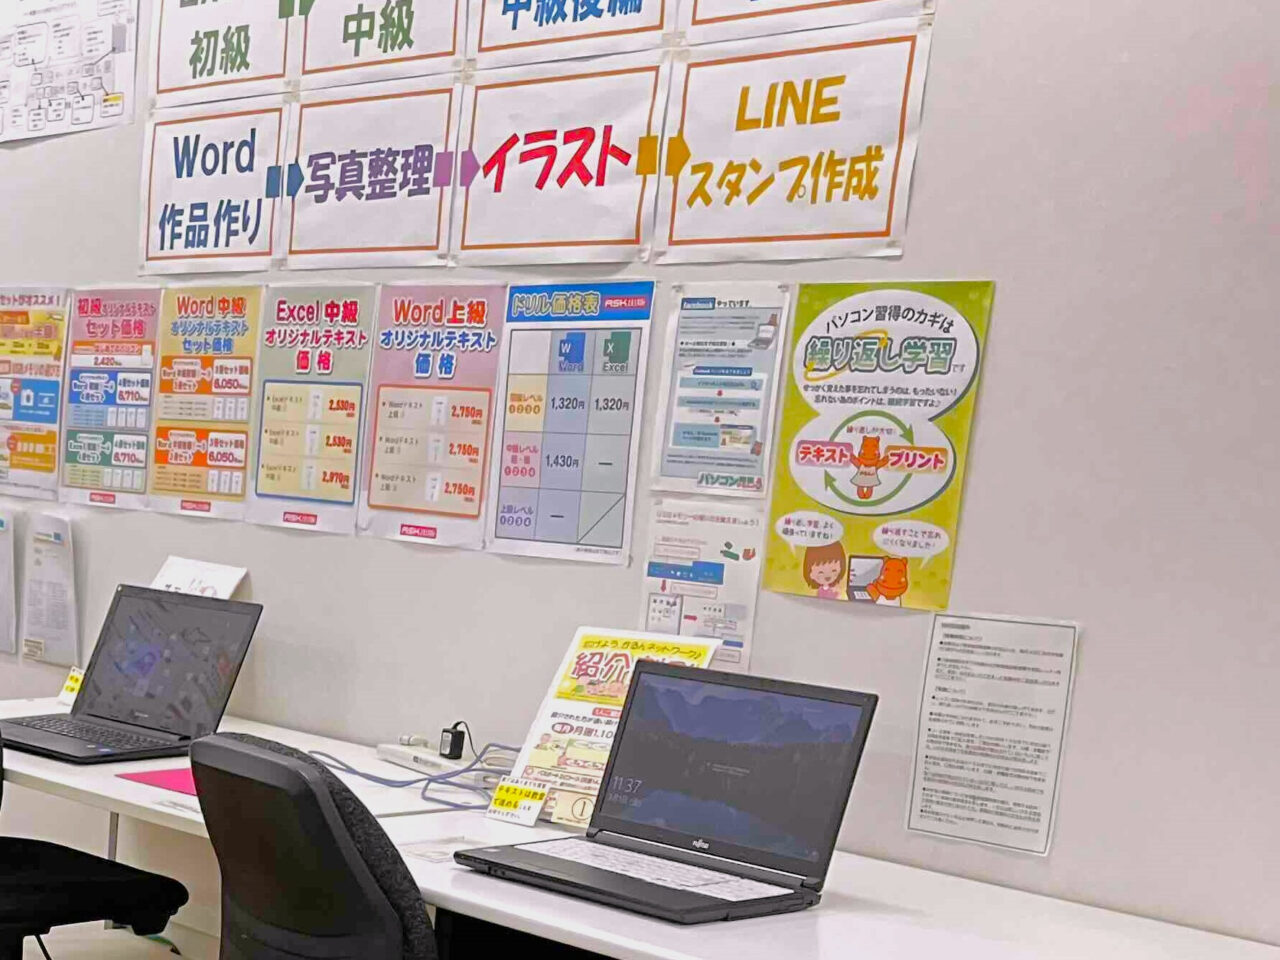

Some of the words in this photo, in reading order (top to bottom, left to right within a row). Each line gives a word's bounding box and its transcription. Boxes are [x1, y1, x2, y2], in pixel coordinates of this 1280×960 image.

[342, 0, 415, 58] 中級
[190, 22, 252, 80] 初級
[735, 74, 845, 133] LINE
[172, 127, 256, 180] Word
[482, 124, 633, 194] イラスト
[303, 142, 436, 204] 写真整理
[685, 146, 880, 209] スタンプ作成
[159, 198, 263, 253] 作品作り
[177, 295, 214, 318] Word
[218, 295, 248, 318] 中級
[275, 299, 320, 323] Excel
[324, 299, 359, 325] 中級
[393, 298, 444, 325] Word
[446, 299, 487, 326] 上級
[511, 290, 601, 318] ドリル価格表
[826, 304, 955, 334] パソコン習得のカギは
[264, 328, 369, 348] オリジナルテキスト
[380, 329, 497, 349] オリジナルテキスト
[295, 349, 333, 373] 価格
[414, 352, 456, 377] 価格
[602, 360, 629, 373] Excel
[804, 336, 957, 375] 繰り返し学習
[550, 396, 585, 412] 1,320円
[594, 397, 629, 412] 1,320円
[545, 454, 579, 469] 1,430円
[799, 444, 850, 464] テキスト
[889, 451, 946, 470] プリント
